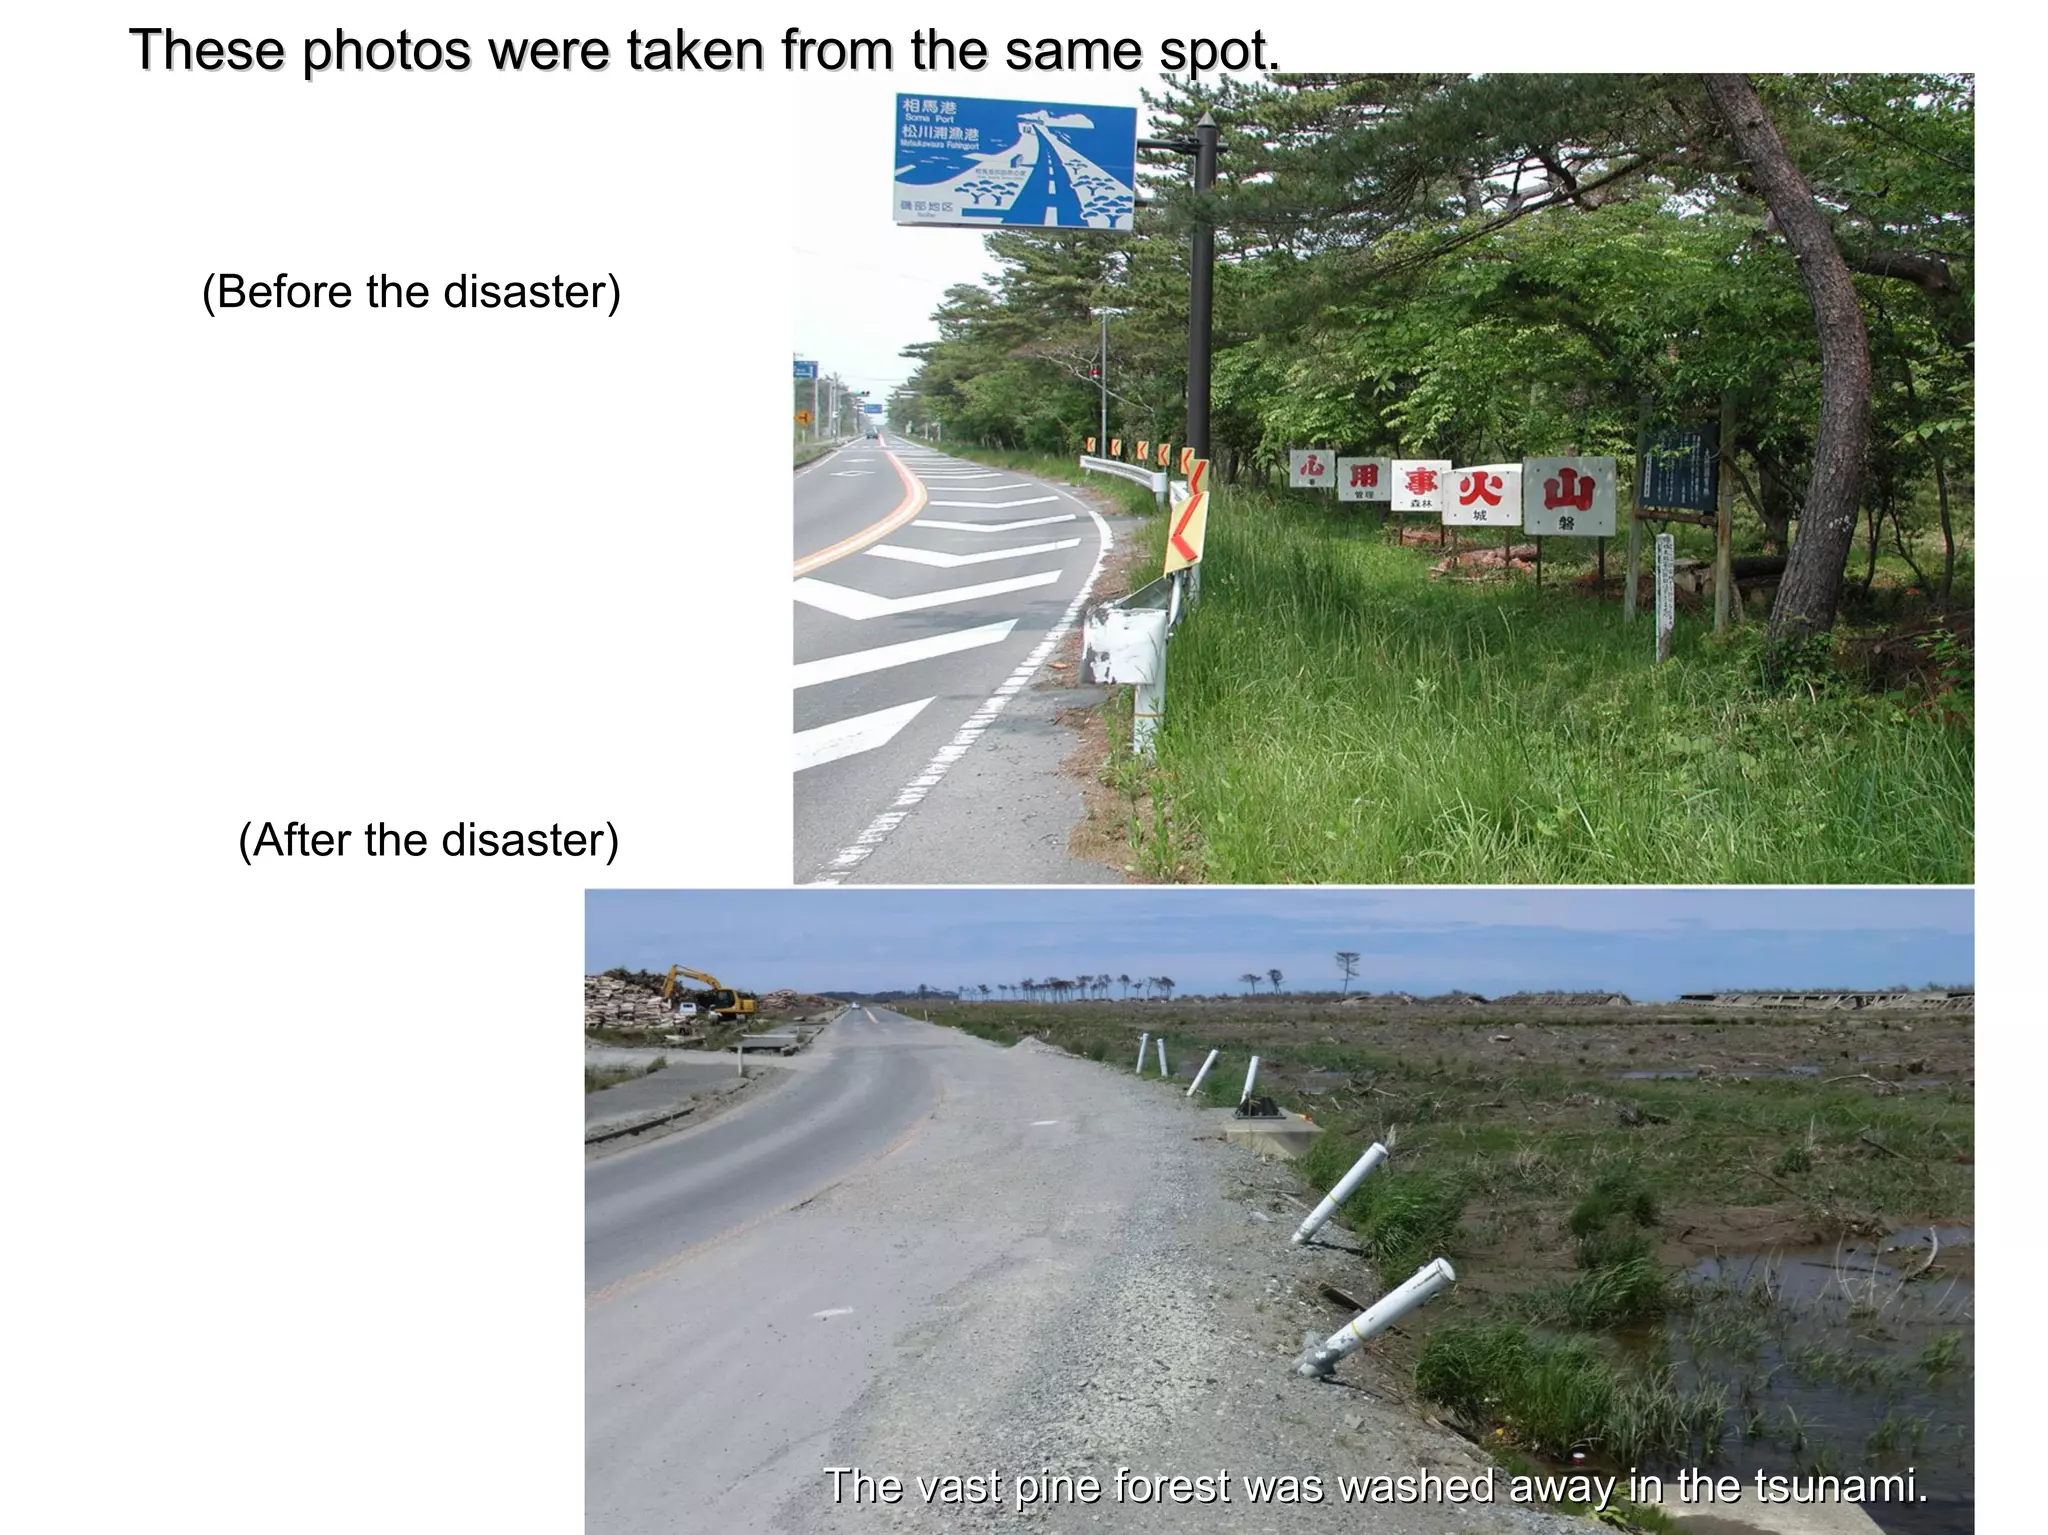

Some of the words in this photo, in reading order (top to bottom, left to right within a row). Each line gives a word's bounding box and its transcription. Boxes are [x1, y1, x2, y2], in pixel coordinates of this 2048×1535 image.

[902, 98, 957, 115] 相馬港
[905, 113, 931, 123] Soma
[936, 115, 955, 124] Port
[902, 124, 979, 142] 松川浦漁港
[1300, 454, 1325, 476] 心
[1350, 463, 1379, 488] 用
[1405, 466, 1438, 495] 事
[1459, 471, 1504, 506] 火
[1543, 467, 1596, 511] 山
[1410, 499, 1433, 508] 森林
[1473, 510, 1487, 521] 城
[1558, 515, 1575, 531] 磐
